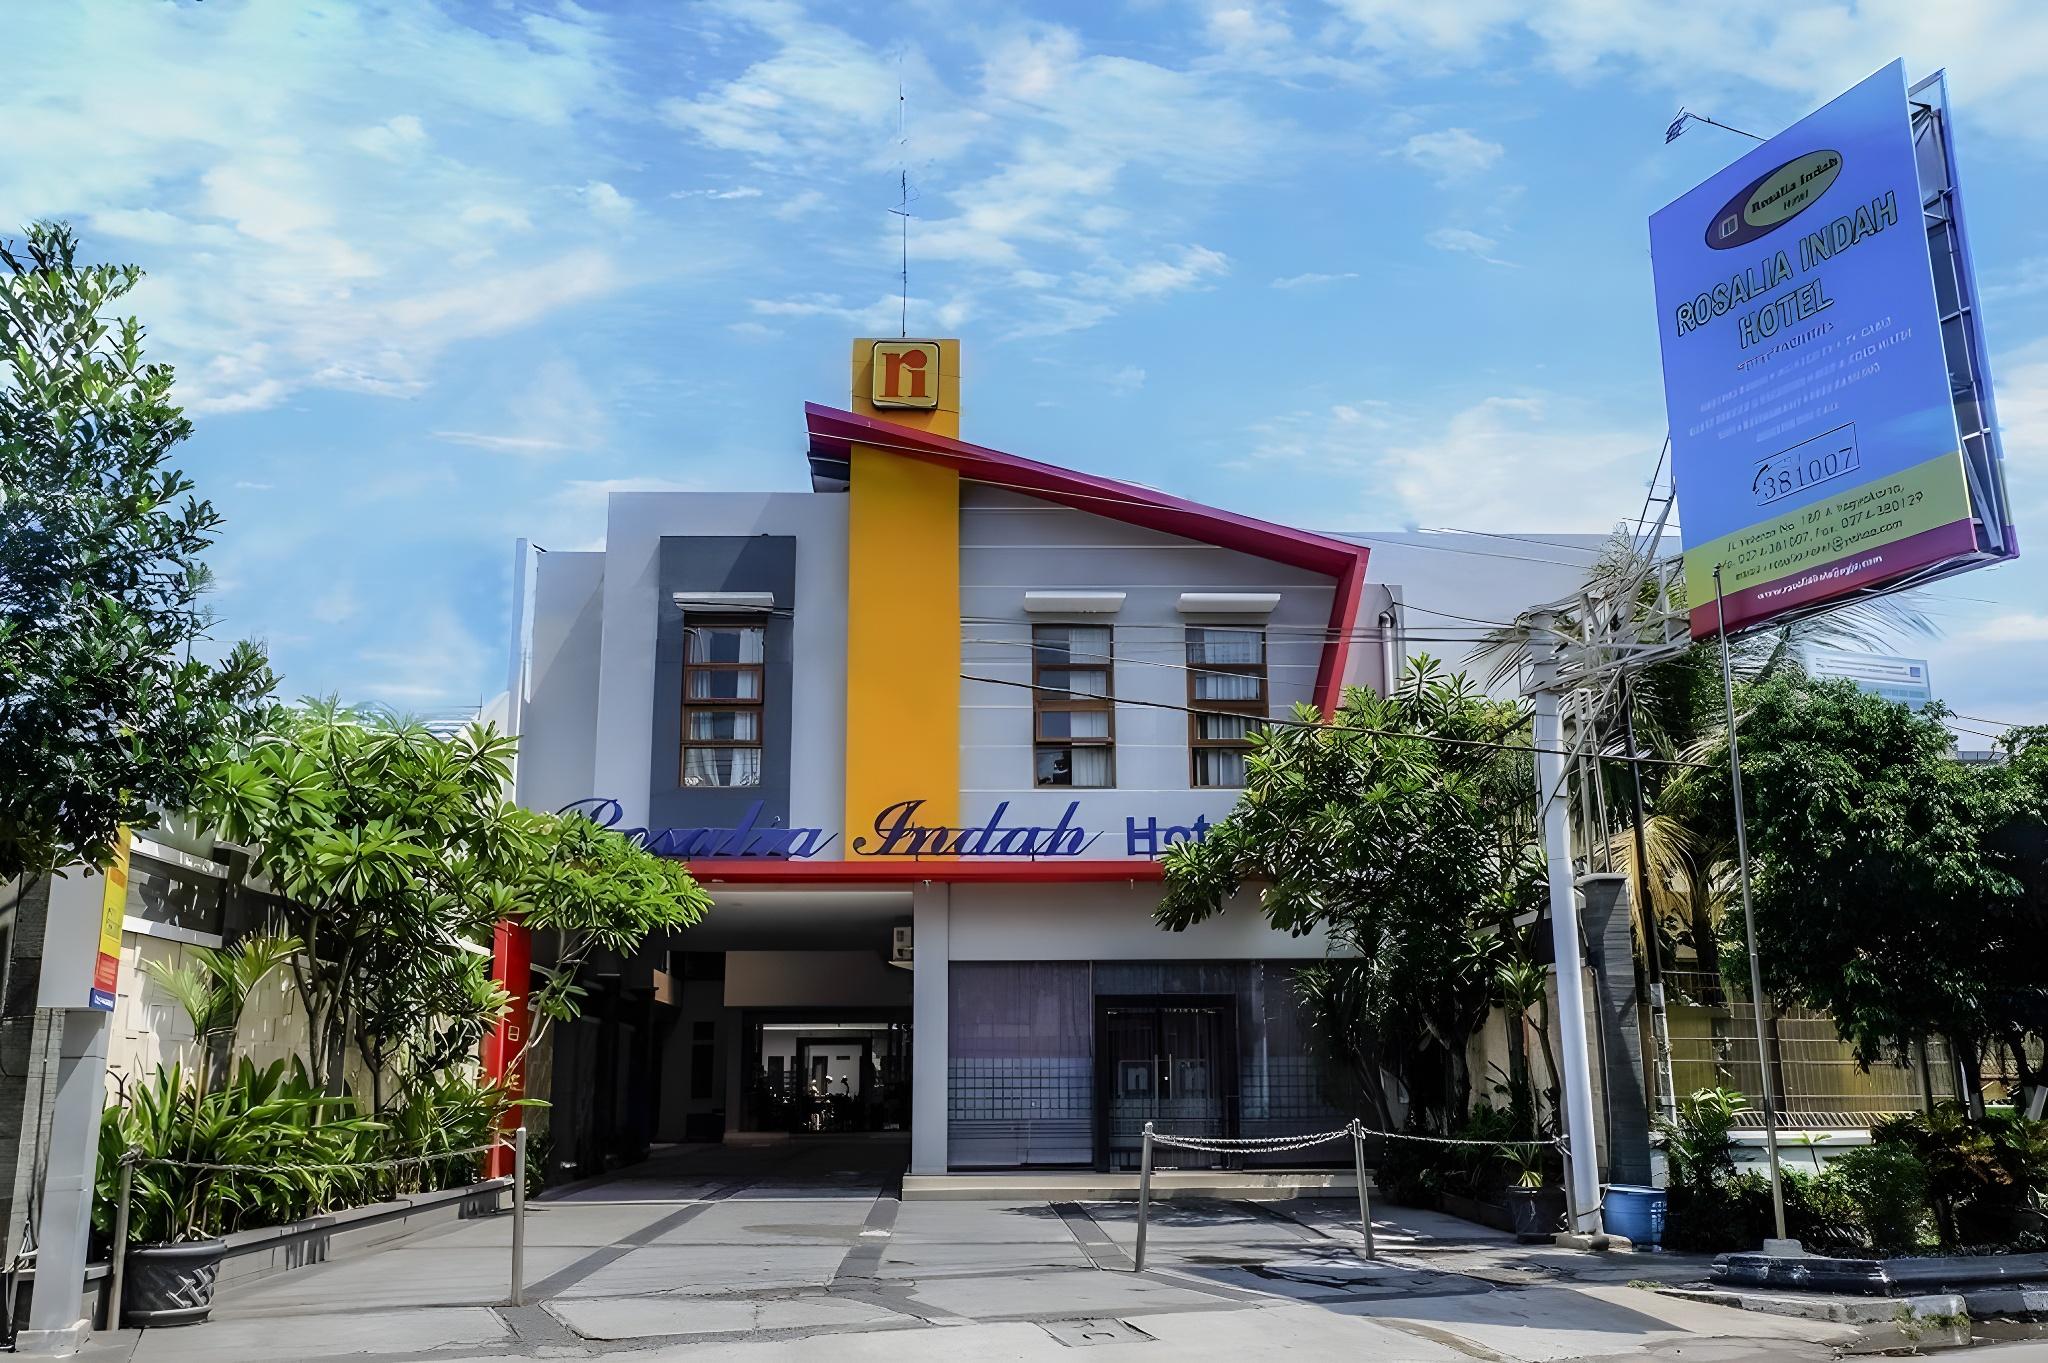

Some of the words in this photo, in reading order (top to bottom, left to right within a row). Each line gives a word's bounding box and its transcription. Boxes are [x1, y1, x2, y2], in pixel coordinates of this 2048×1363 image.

[1676, 249, 1794, 337] ROSALIA
[1799, 190, 1899, 272] INDAH
[1738, 278, 1835, 350] HOTEL
[1763, 446, 1854, 500] 381007
[853, 799, 1104, 858] Indah
